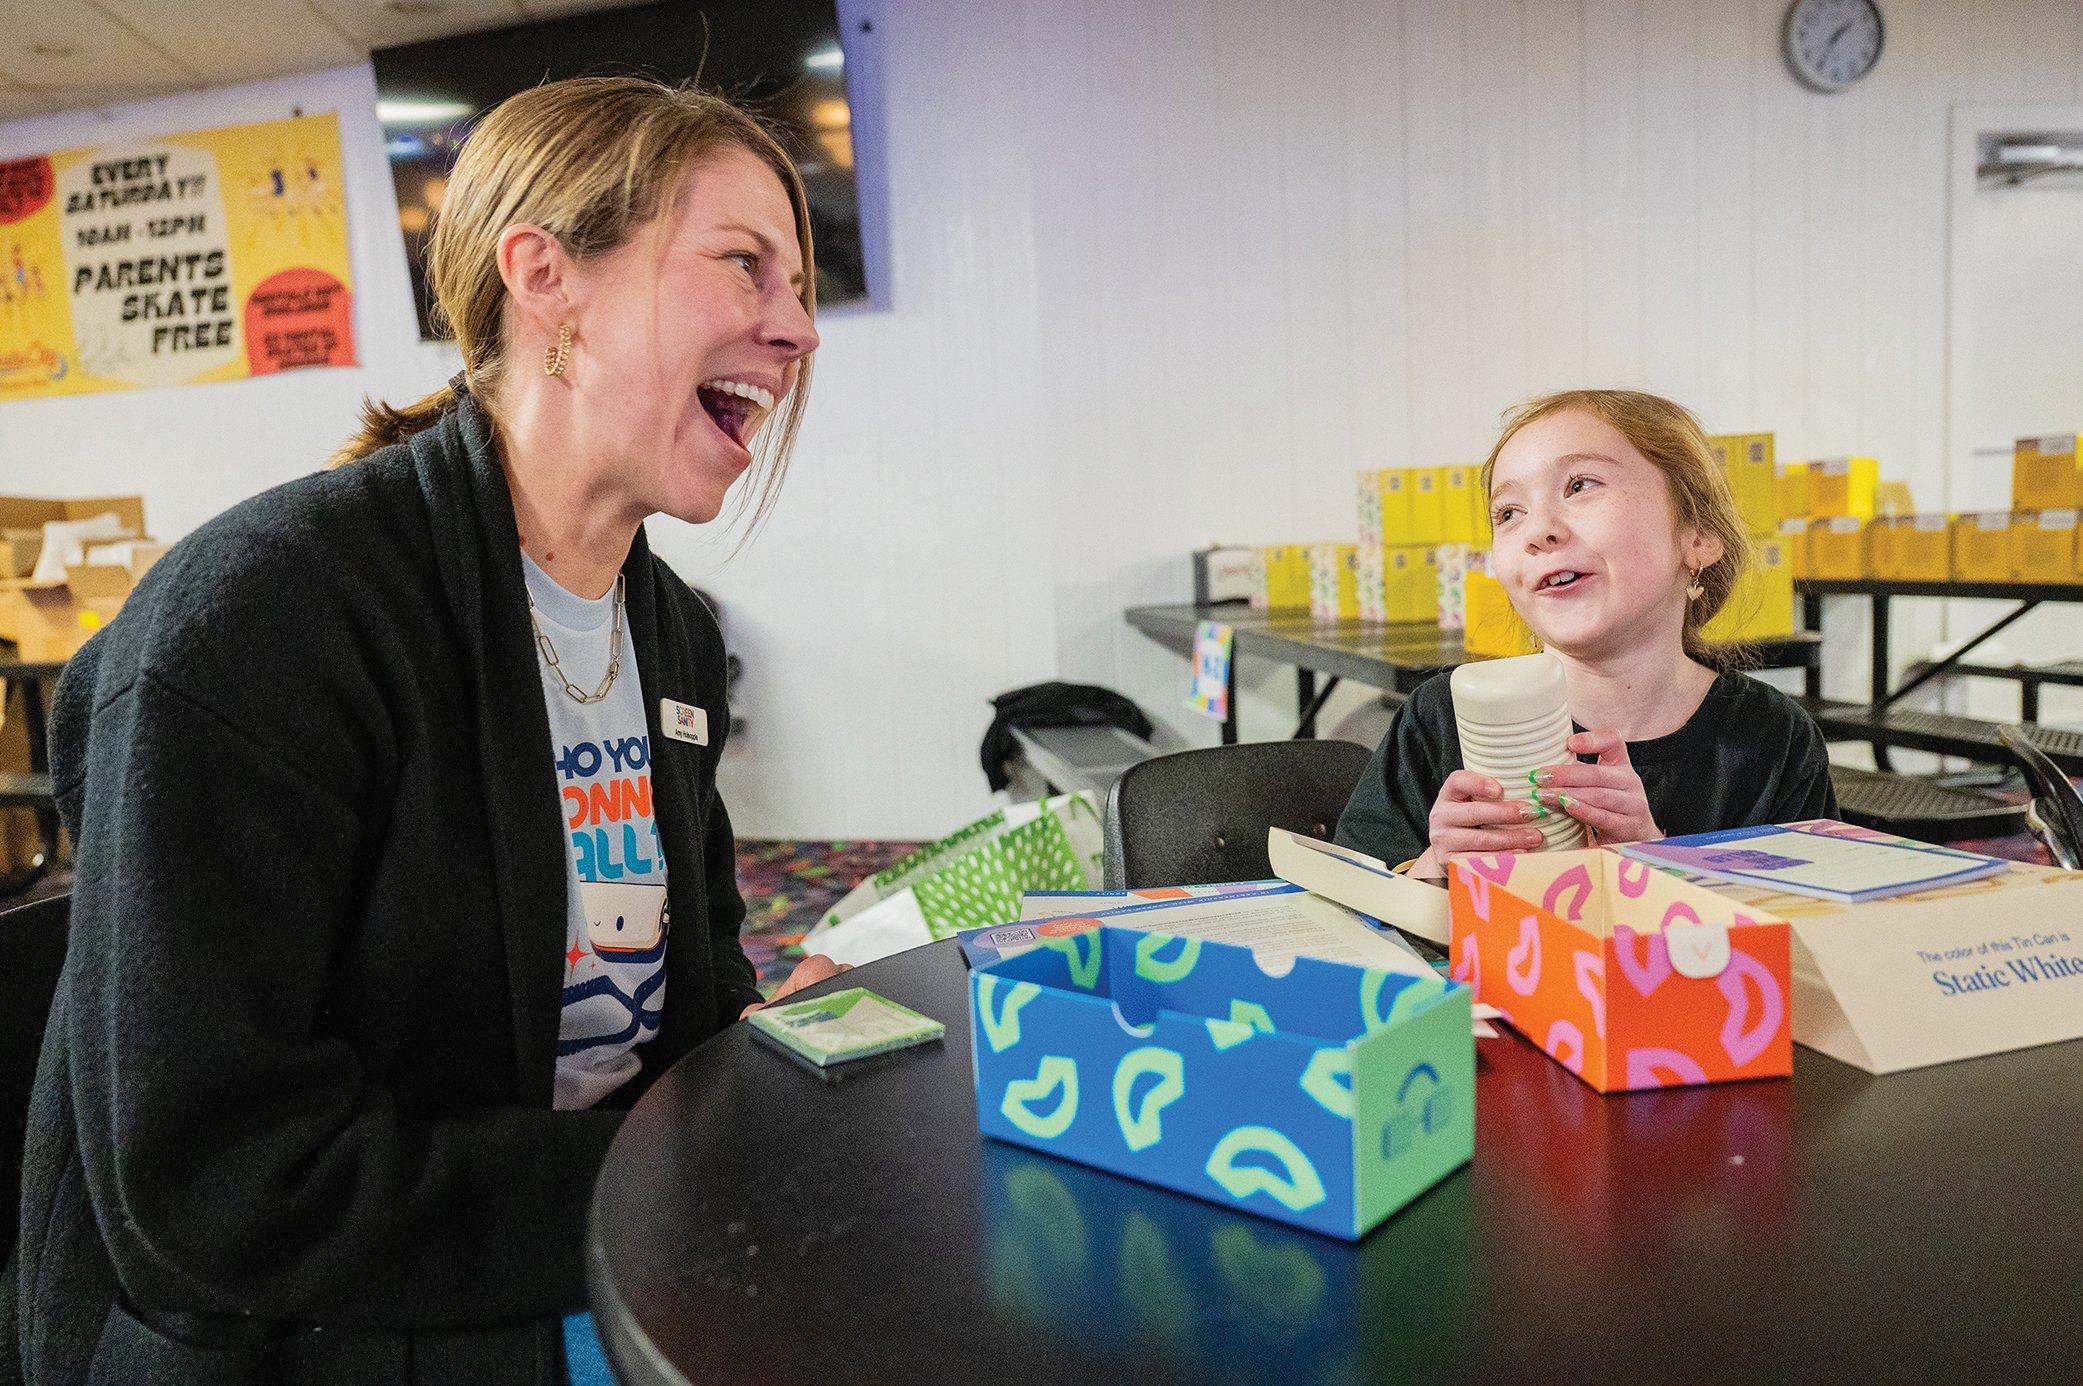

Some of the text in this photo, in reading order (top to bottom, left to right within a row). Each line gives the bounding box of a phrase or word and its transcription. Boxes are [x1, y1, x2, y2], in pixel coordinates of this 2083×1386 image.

[91, 154, 168, 186] EVERY
[77, 222, 131, 248] 10AM
[147, 213, 206, 241] 12PM
[73, 250, 226, 295] PARENTS
[120, 285, 229, 323] SKATE
[152, 320, 234, 354] FREE
[677, 715, 694, 728] SANITY
[1917, 931, 2071, 963] The color of this Tin Can is
[1932, 953, 2083, 996] Static White
